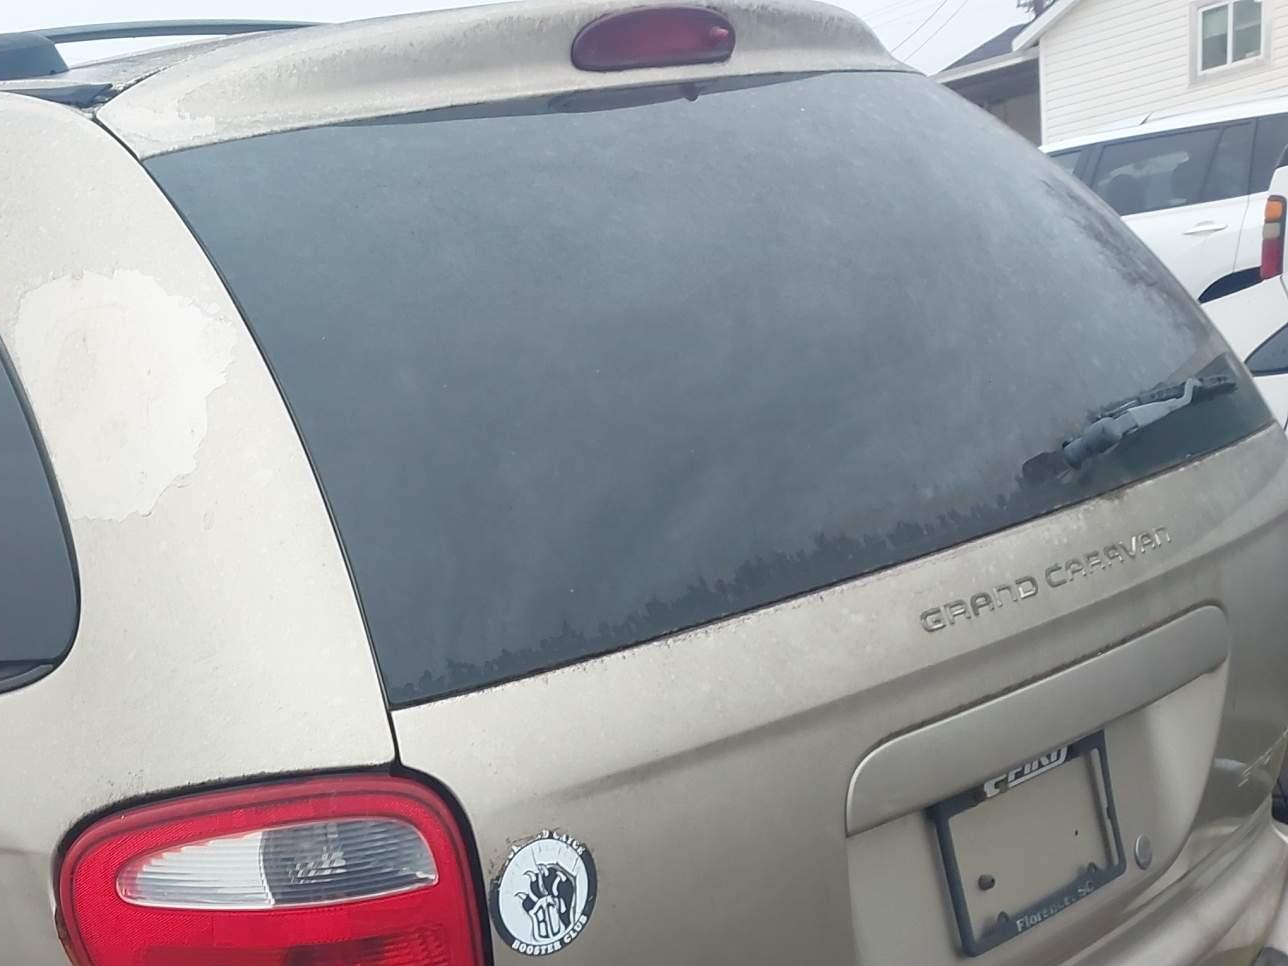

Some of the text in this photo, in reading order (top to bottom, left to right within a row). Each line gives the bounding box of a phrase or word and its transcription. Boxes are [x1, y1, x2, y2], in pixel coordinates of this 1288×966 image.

[919, 526, 1174, 633] GRAND CARAVAN
[511, 914, 588, 956] BOOSTER CLUB
